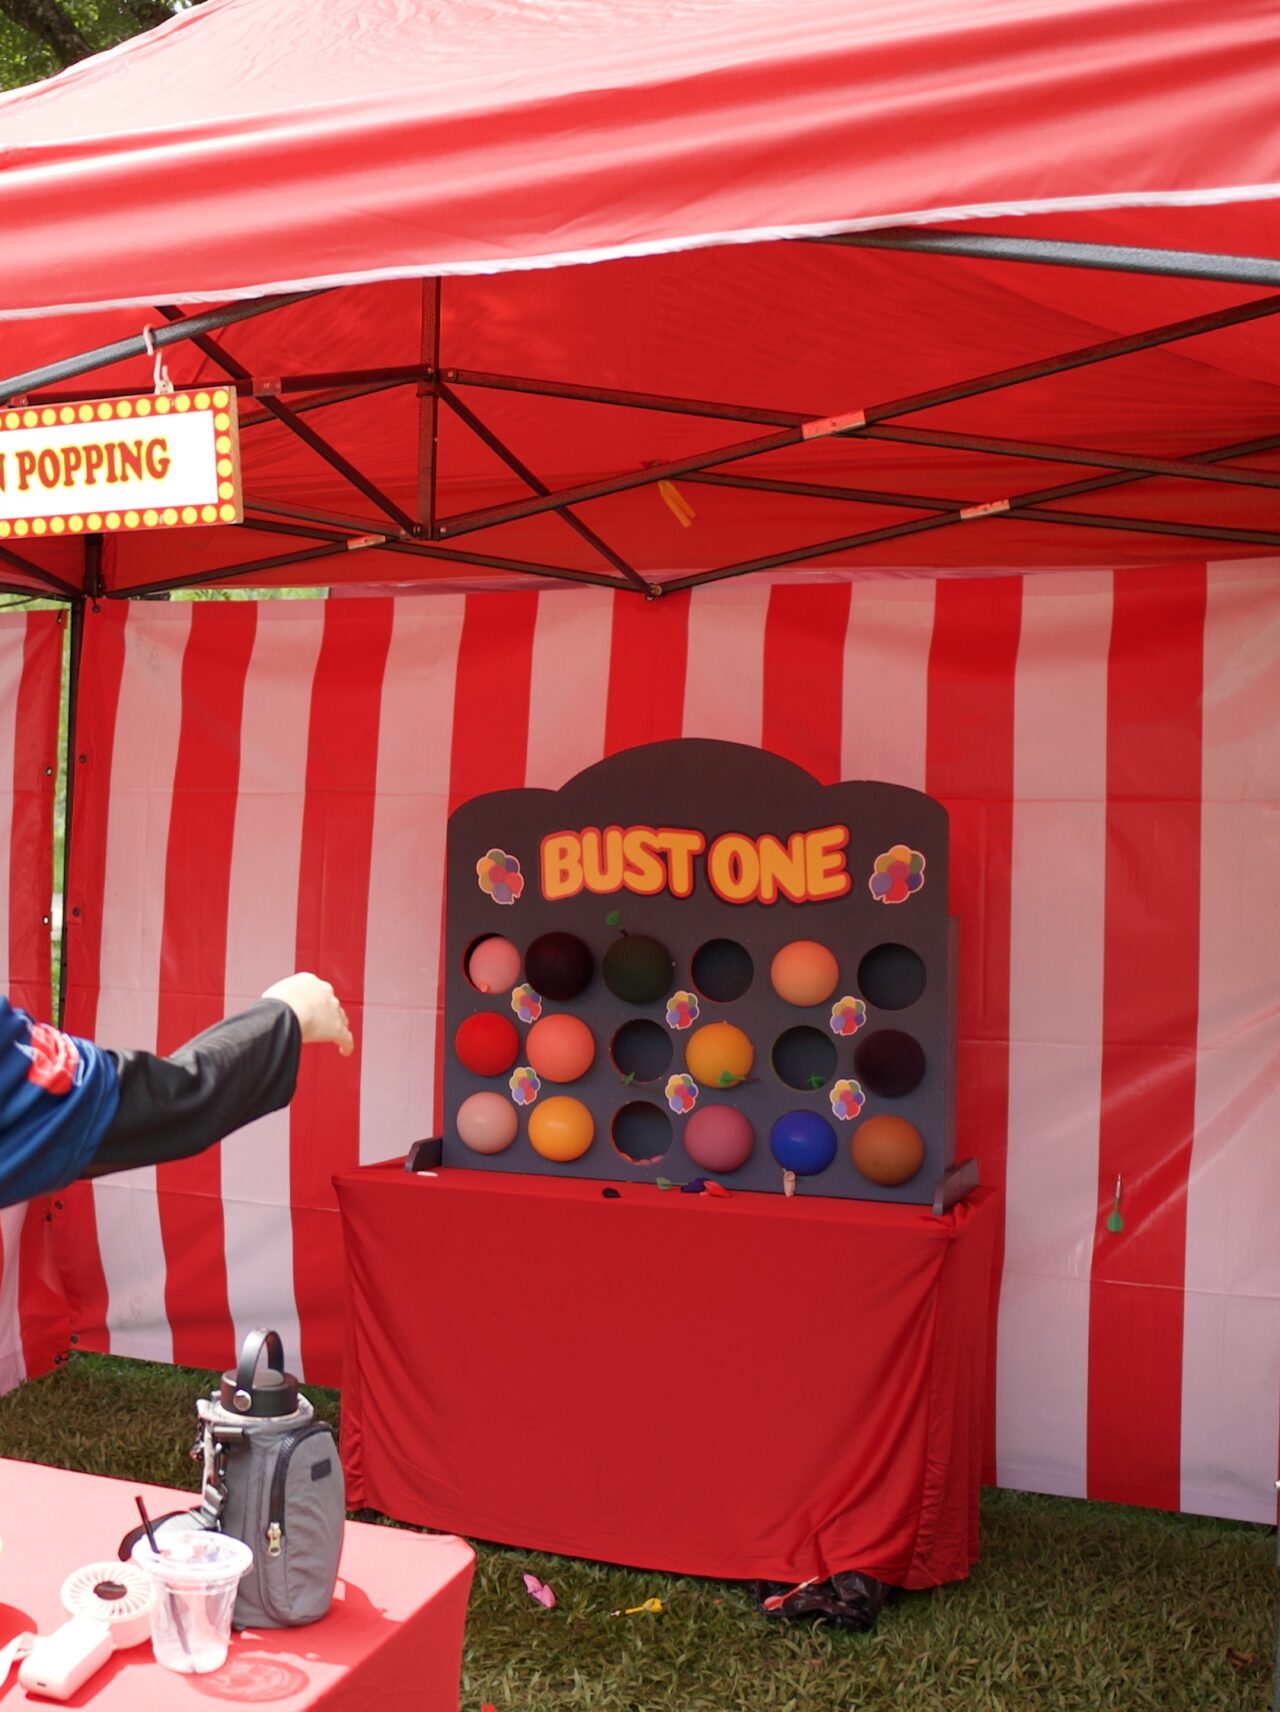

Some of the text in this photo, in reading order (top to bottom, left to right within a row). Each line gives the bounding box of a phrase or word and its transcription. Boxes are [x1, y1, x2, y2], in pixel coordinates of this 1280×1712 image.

[16, 437, 172, 491] POPPING
[540, 824, 852, 905] BUST ONE
